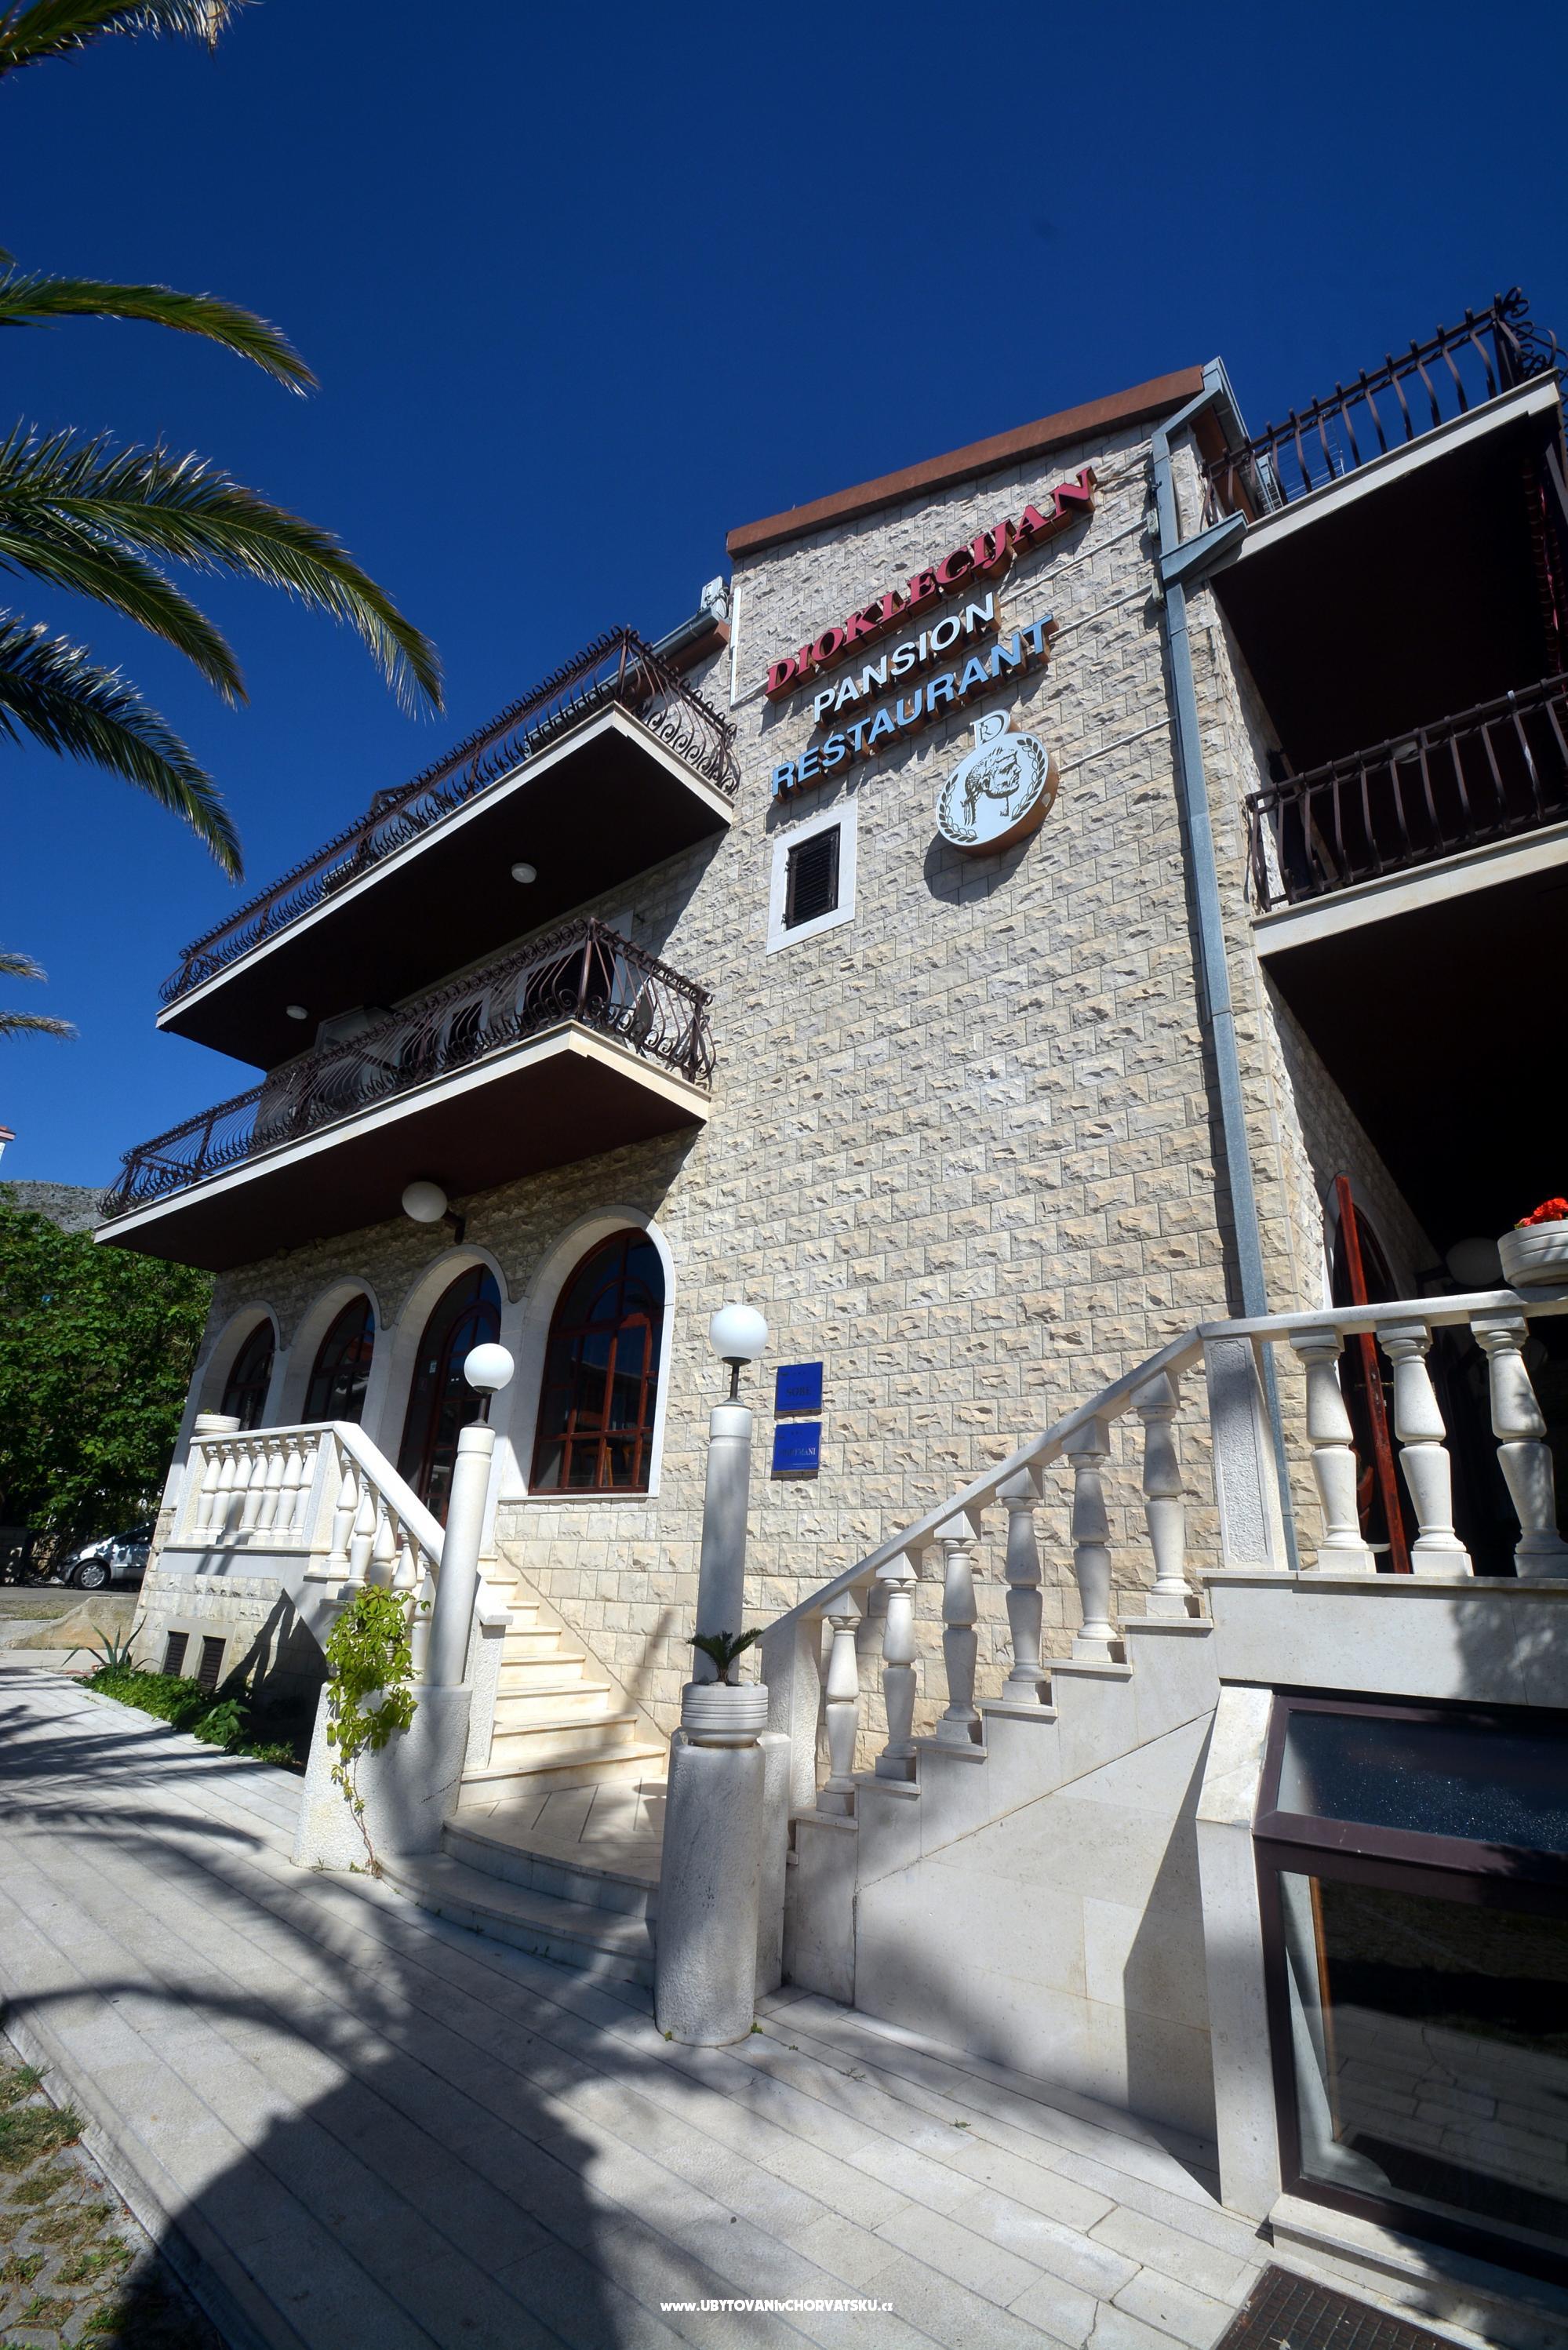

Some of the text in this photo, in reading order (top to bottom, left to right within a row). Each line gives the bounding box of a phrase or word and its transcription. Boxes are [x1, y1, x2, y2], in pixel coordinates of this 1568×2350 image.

[765, 466, 1097, 697] DIOKLECIJAN
[813, 592, 995, 724] PANSION
[772, 614, 1053, 797] RESTAURANT
